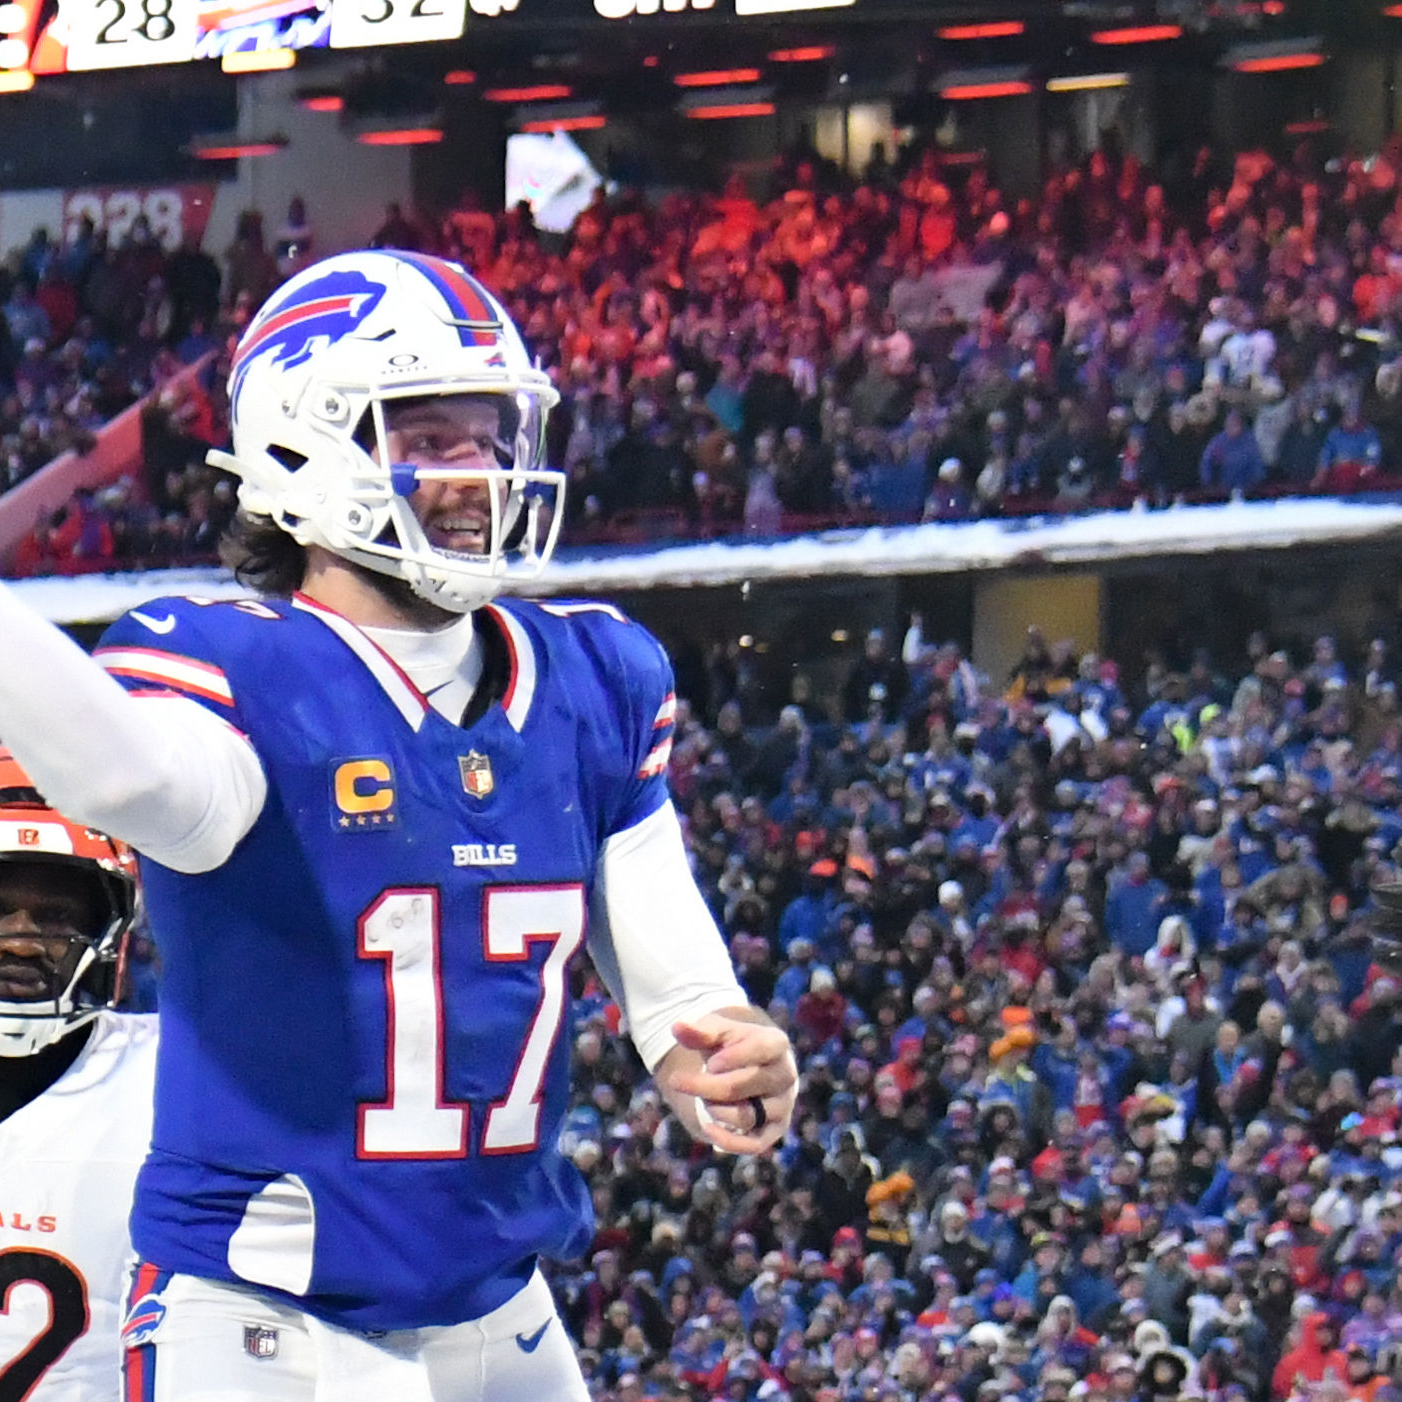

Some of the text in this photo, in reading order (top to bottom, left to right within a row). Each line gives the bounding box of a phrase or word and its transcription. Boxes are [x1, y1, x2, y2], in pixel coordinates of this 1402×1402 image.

[334, 760, 393, 814] C
[452, 844, 517, 866] BILLS
[356, 882, 585, 1159] 17
